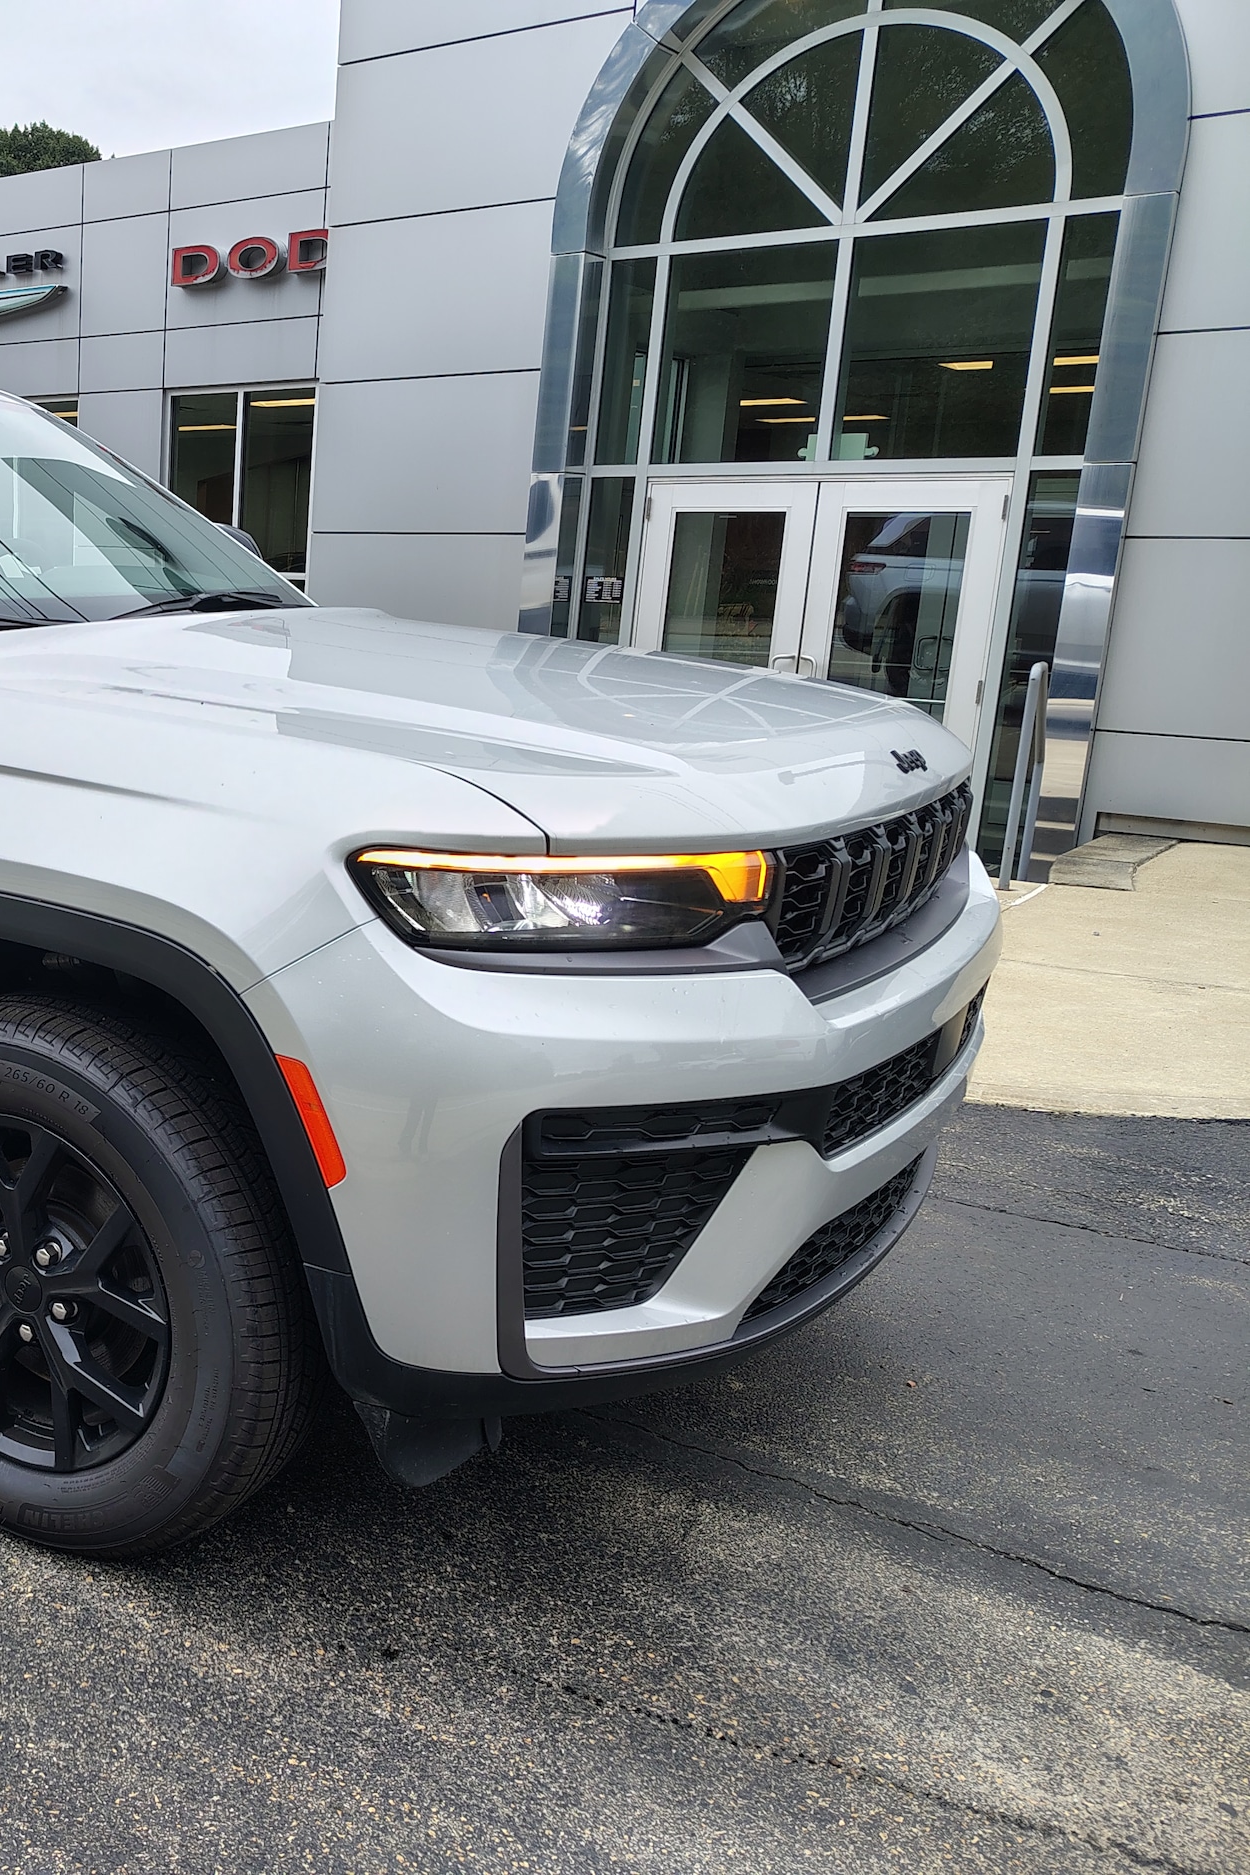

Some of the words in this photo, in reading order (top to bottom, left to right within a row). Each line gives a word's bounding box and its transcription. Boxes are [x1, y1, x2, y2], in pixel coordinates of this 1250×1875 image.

[4, 1066, 56, 1094] 265/60
[58, 1090, 70, 1103] R
[73, 1100, 89, 1116] 18
